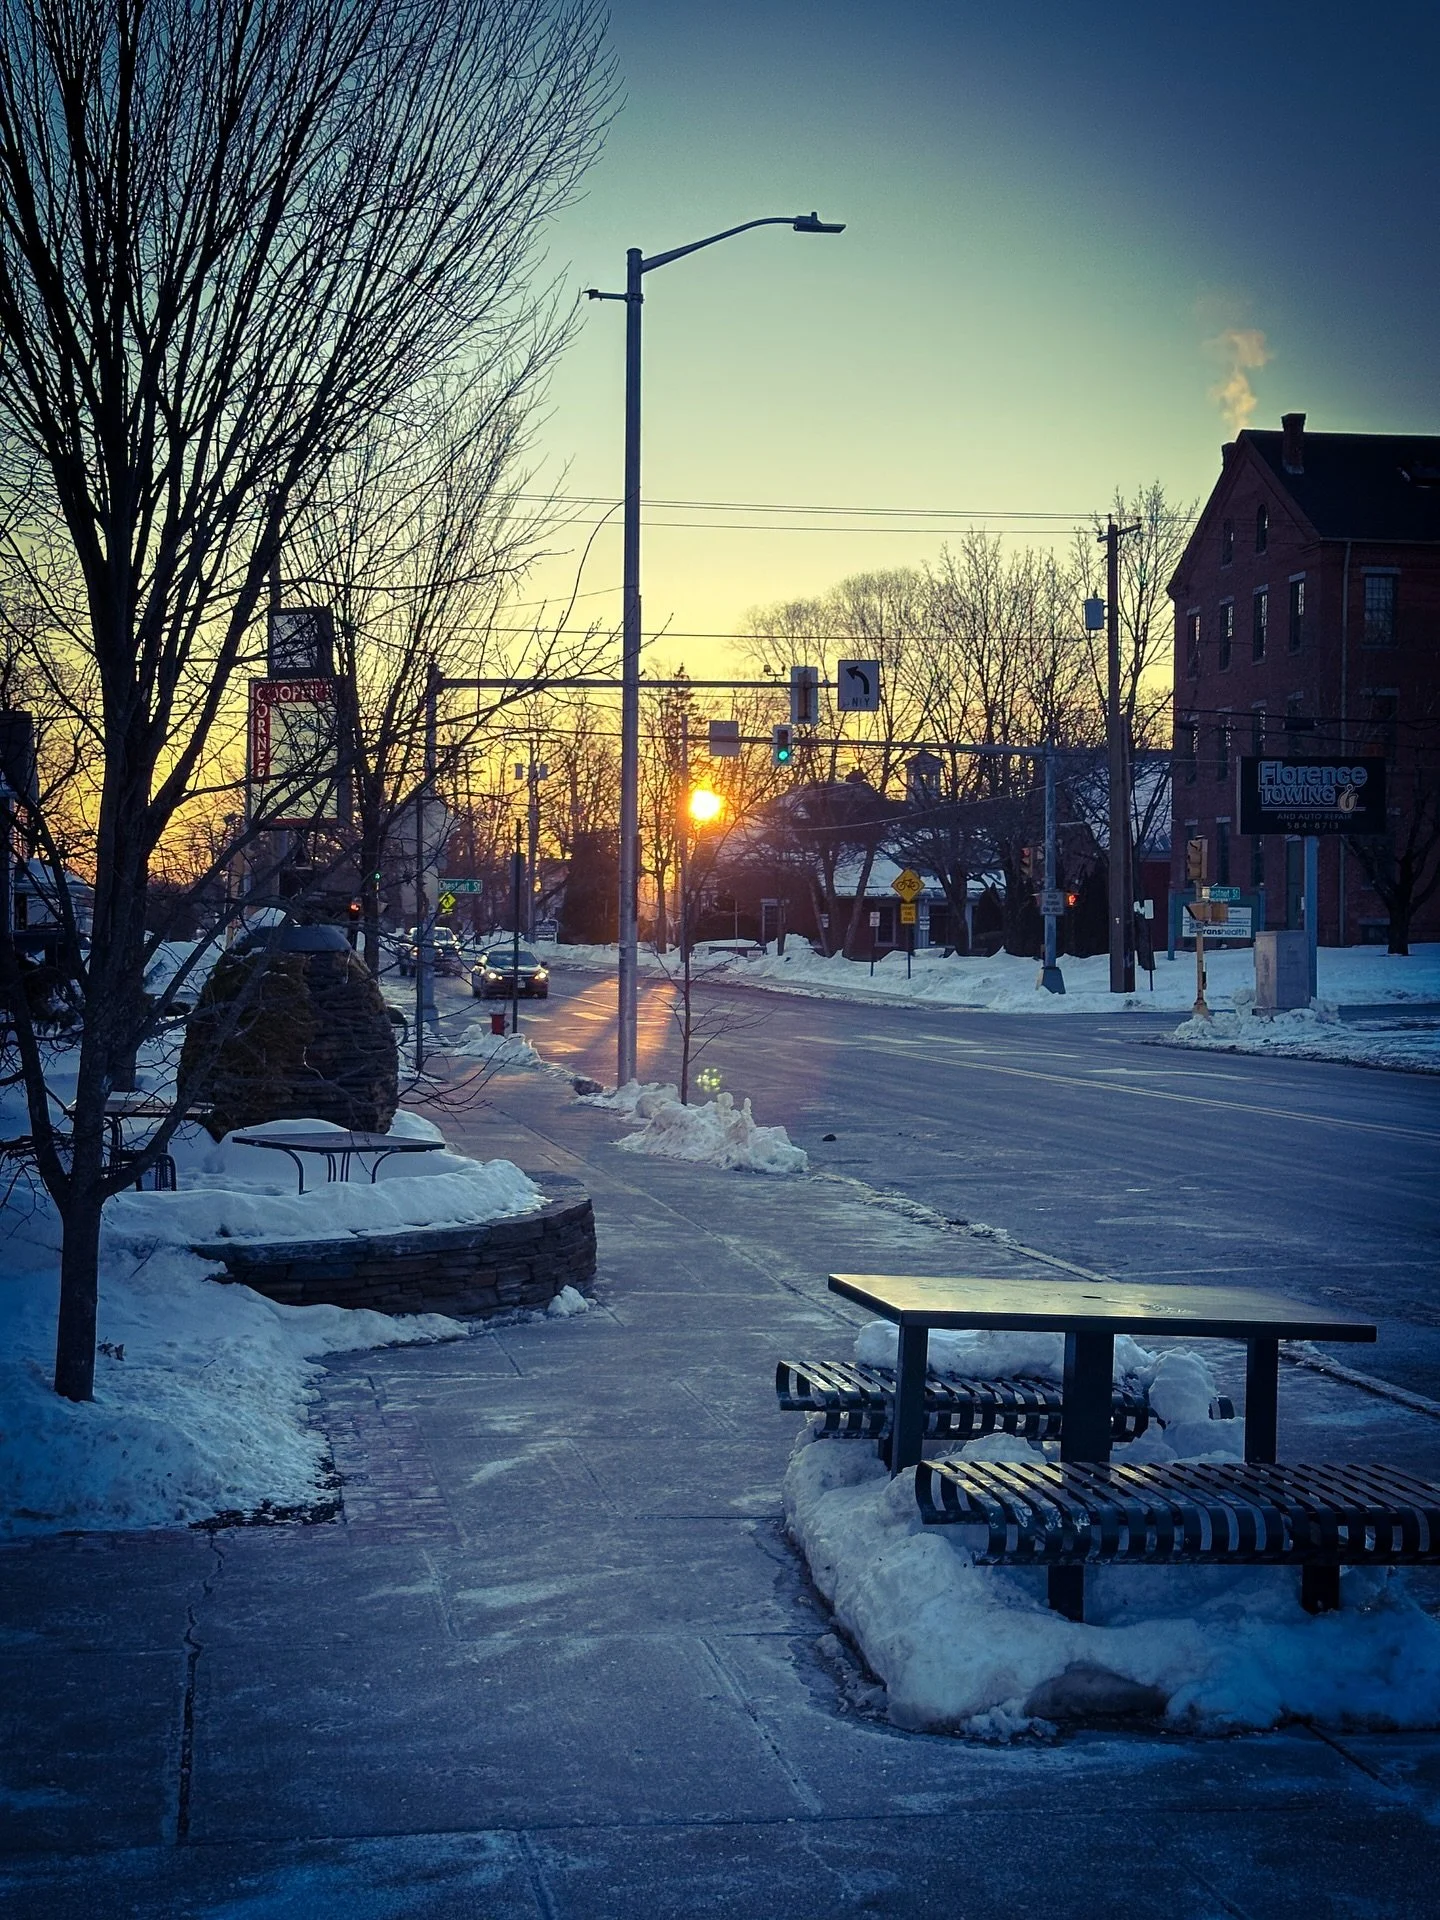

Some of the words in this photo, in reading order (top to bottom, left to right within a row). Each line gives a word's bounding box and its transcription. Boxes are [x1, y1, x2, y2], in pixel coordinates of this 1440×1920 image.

[1259, 761, 1368, 787] Florence
[1259, 785, 1336, 805] TOWING
[1324, 813, 1353, 821] REPAIR
[439, 881, 470, 891] Chestnut
[1203, 927, 1248, 937] ranshealth
